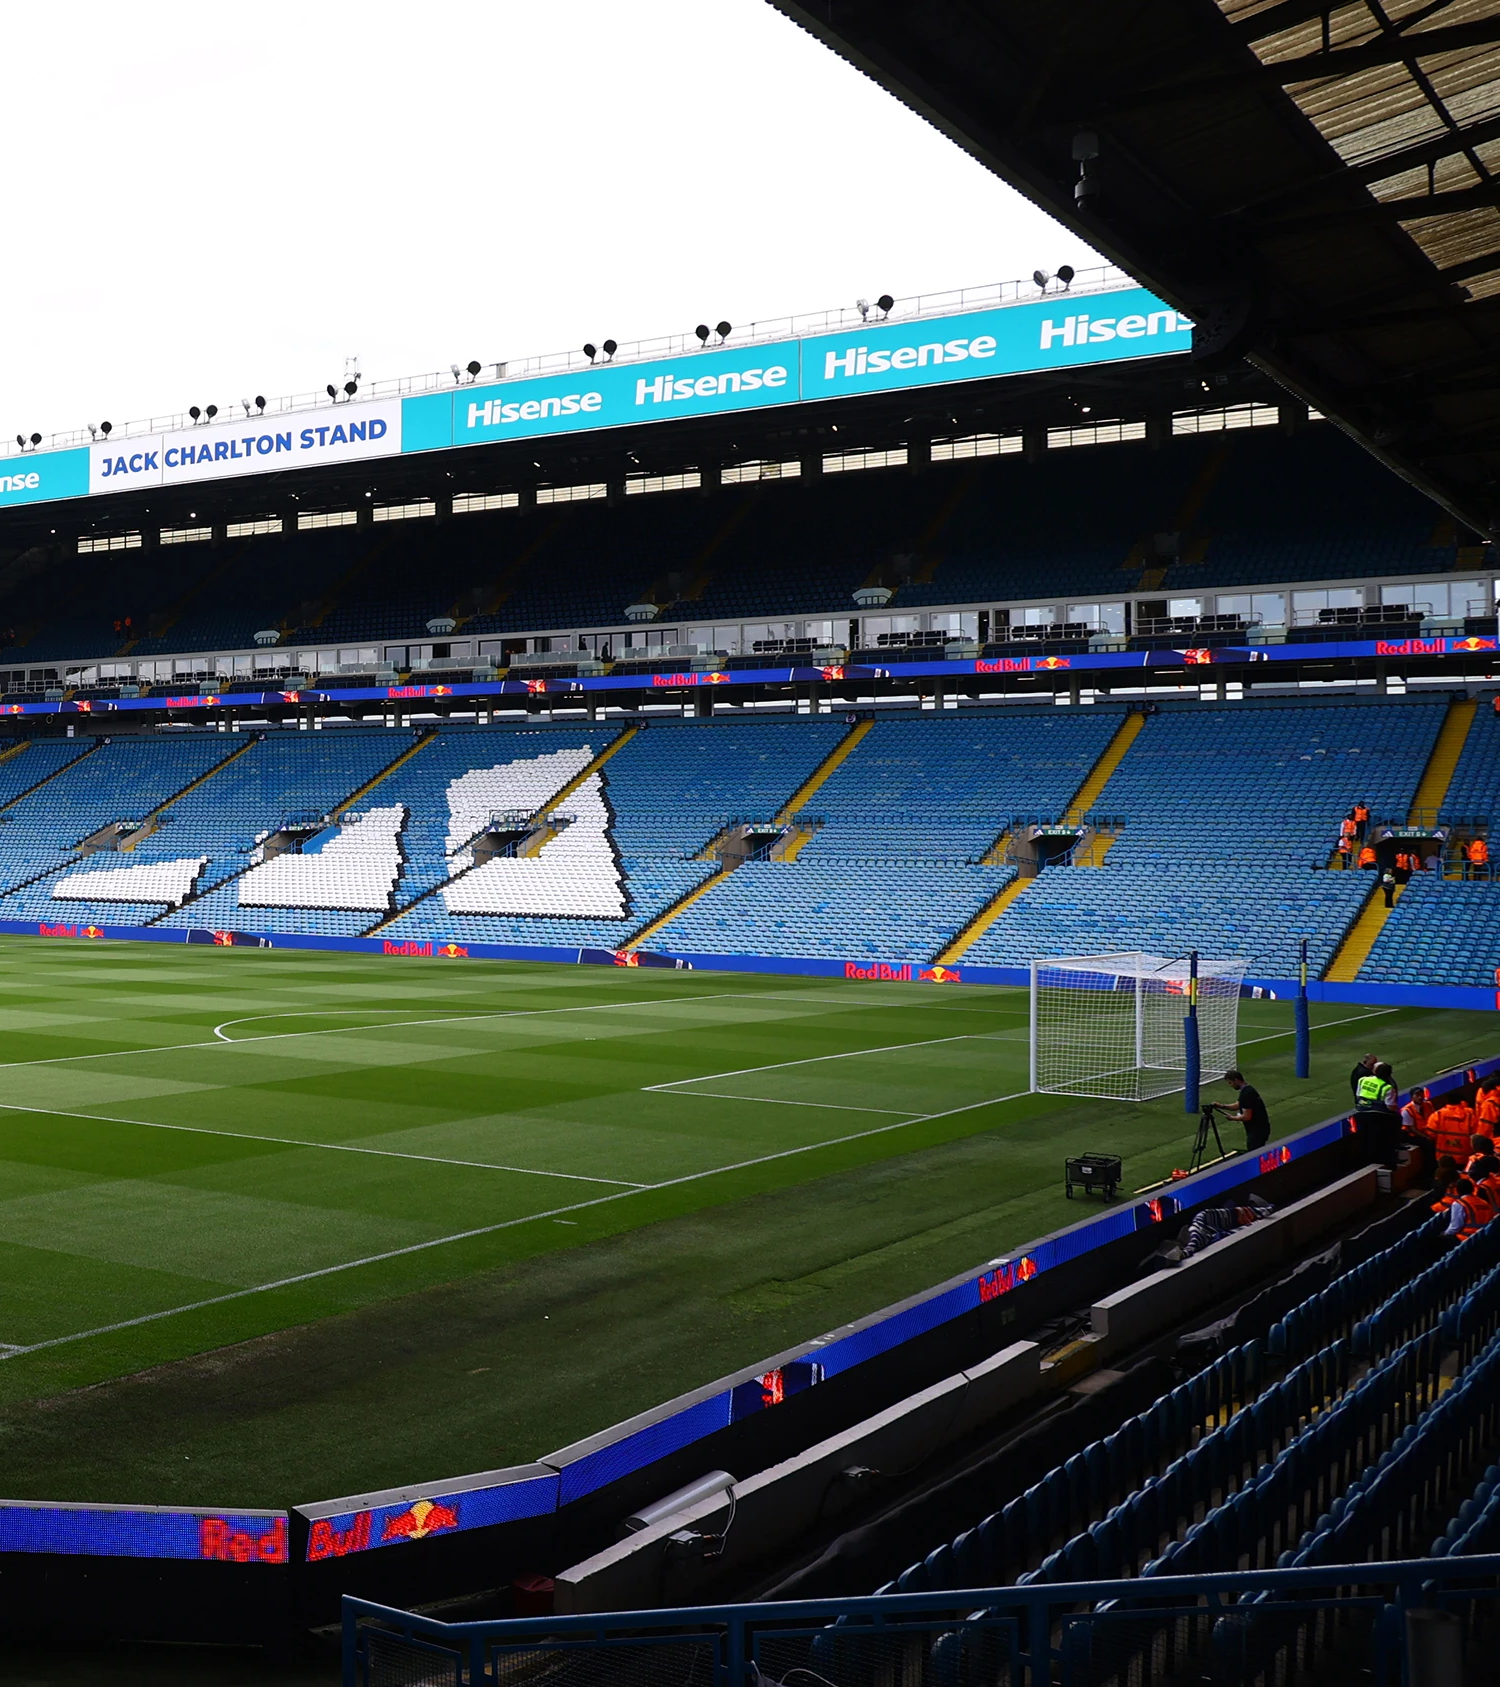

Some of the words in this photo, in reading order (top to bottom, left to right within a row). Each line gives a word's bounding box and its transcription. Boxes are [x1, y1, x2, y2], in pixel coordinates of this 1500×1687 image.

[1040, 312, 1197, 350] Hisens
[824, 336, 997, 379] Hisense
[635, 366, 787, 405] Hisense
[467, 392, 602, 428] Hisense
[101, 451, 159, 477] JACK
[165, 432, 292, 467] CHARLTON
[300, 419, 387, 449] STAND
[1376, 641, 1410, 654] Red
[1411, 639, 1445, 653] Bull
[975, 659, 1003, 672] Red
[1003, 658, 1030, 671] Bull
[653, 674, 675, 686] Red
[676, 673, 698, 685] Bull
[388, 687, 407, 698] Red
[407, 685, 426, 697] Bull
[40, 924, 58, 937] Red
[58, 924, 77, 937] Bull
[384, 941, 409, 955] Red
[410, 942, 432, 956] Bull
[845, 962, 878, 980] Red
[880, 964, 912, 981] Bull
[202, 1517, 288, 1564] Red
[308, 1511, 372, 1561] Bull
